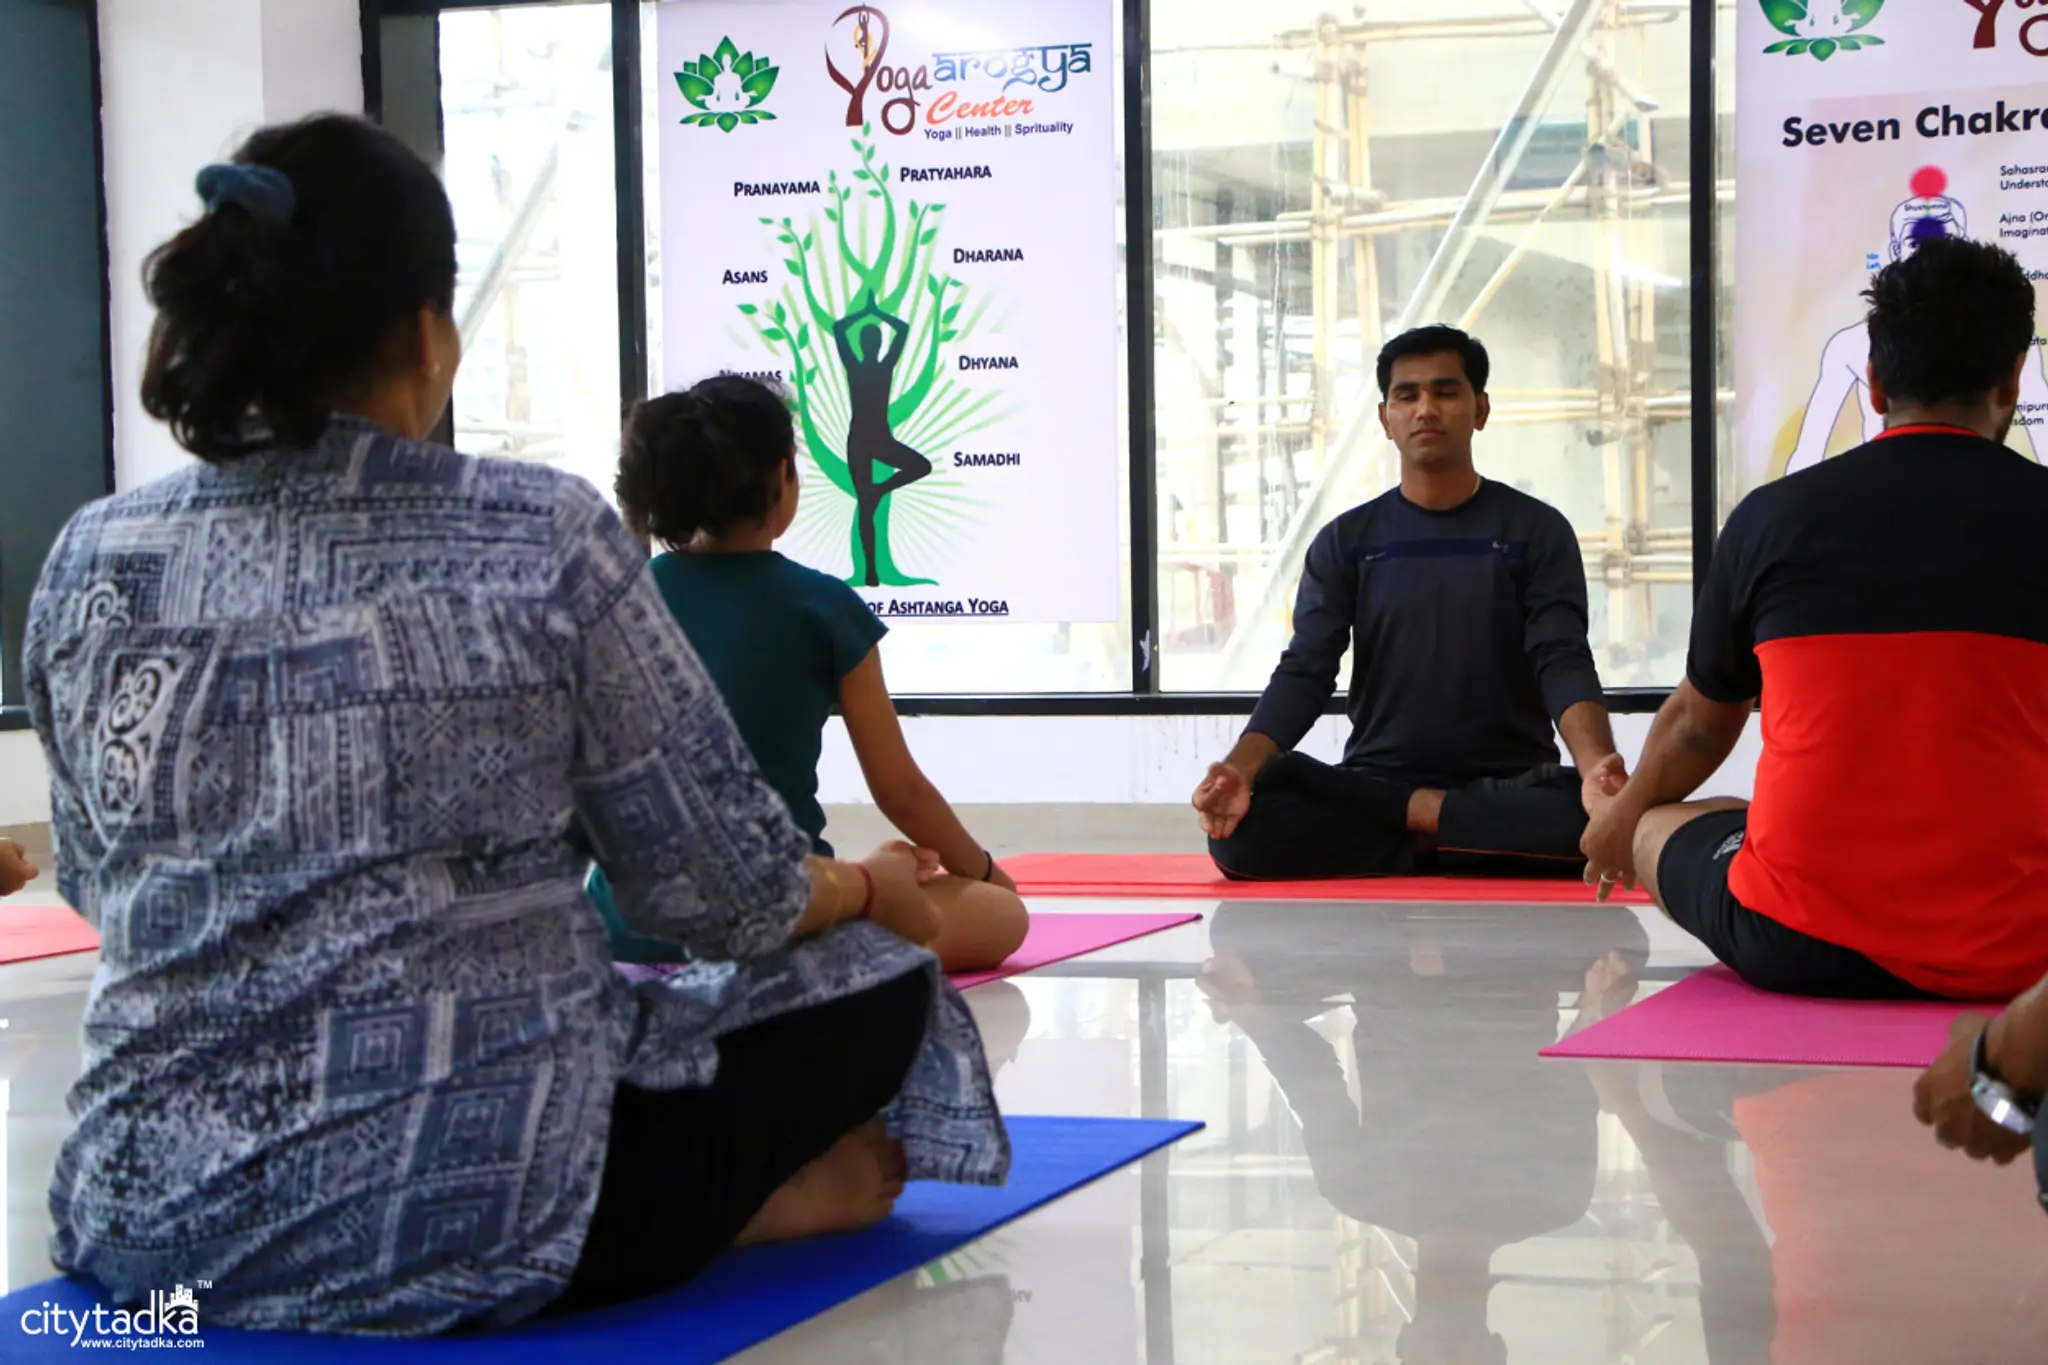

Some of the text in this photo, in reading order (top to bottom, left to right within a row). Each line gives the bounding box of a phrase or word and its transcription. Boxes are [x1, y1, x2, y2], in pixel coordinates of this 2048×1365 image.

[931, 43, 1092, 92] arogya
[926, 91, 1034, 125] Center
[924, 128, 952, 141] Yoga
[965, 125, 1001, 137] Health
[1015, 121, 1074, 135] Sprituality
[1782, 116, 1900, 148] Seven
[900, 165, 992, 183] PRATYAHARA
[2000, 164, 2048, 177] Sahasra
[734, 180, 821, 197] PRANAYAMA
[1999, 213, 2026, 225] Ajna
[953, 247, 1024, 264] DHARANA
[722, 268, 768, 285] ASANS
[958, 354, 1019, 371] DHYANA
[953, 450, 1020, 467] SAMADHI
[888, 598, 964, 615] ASHTANGA
[968, 598, 1009, 615] YOGA
